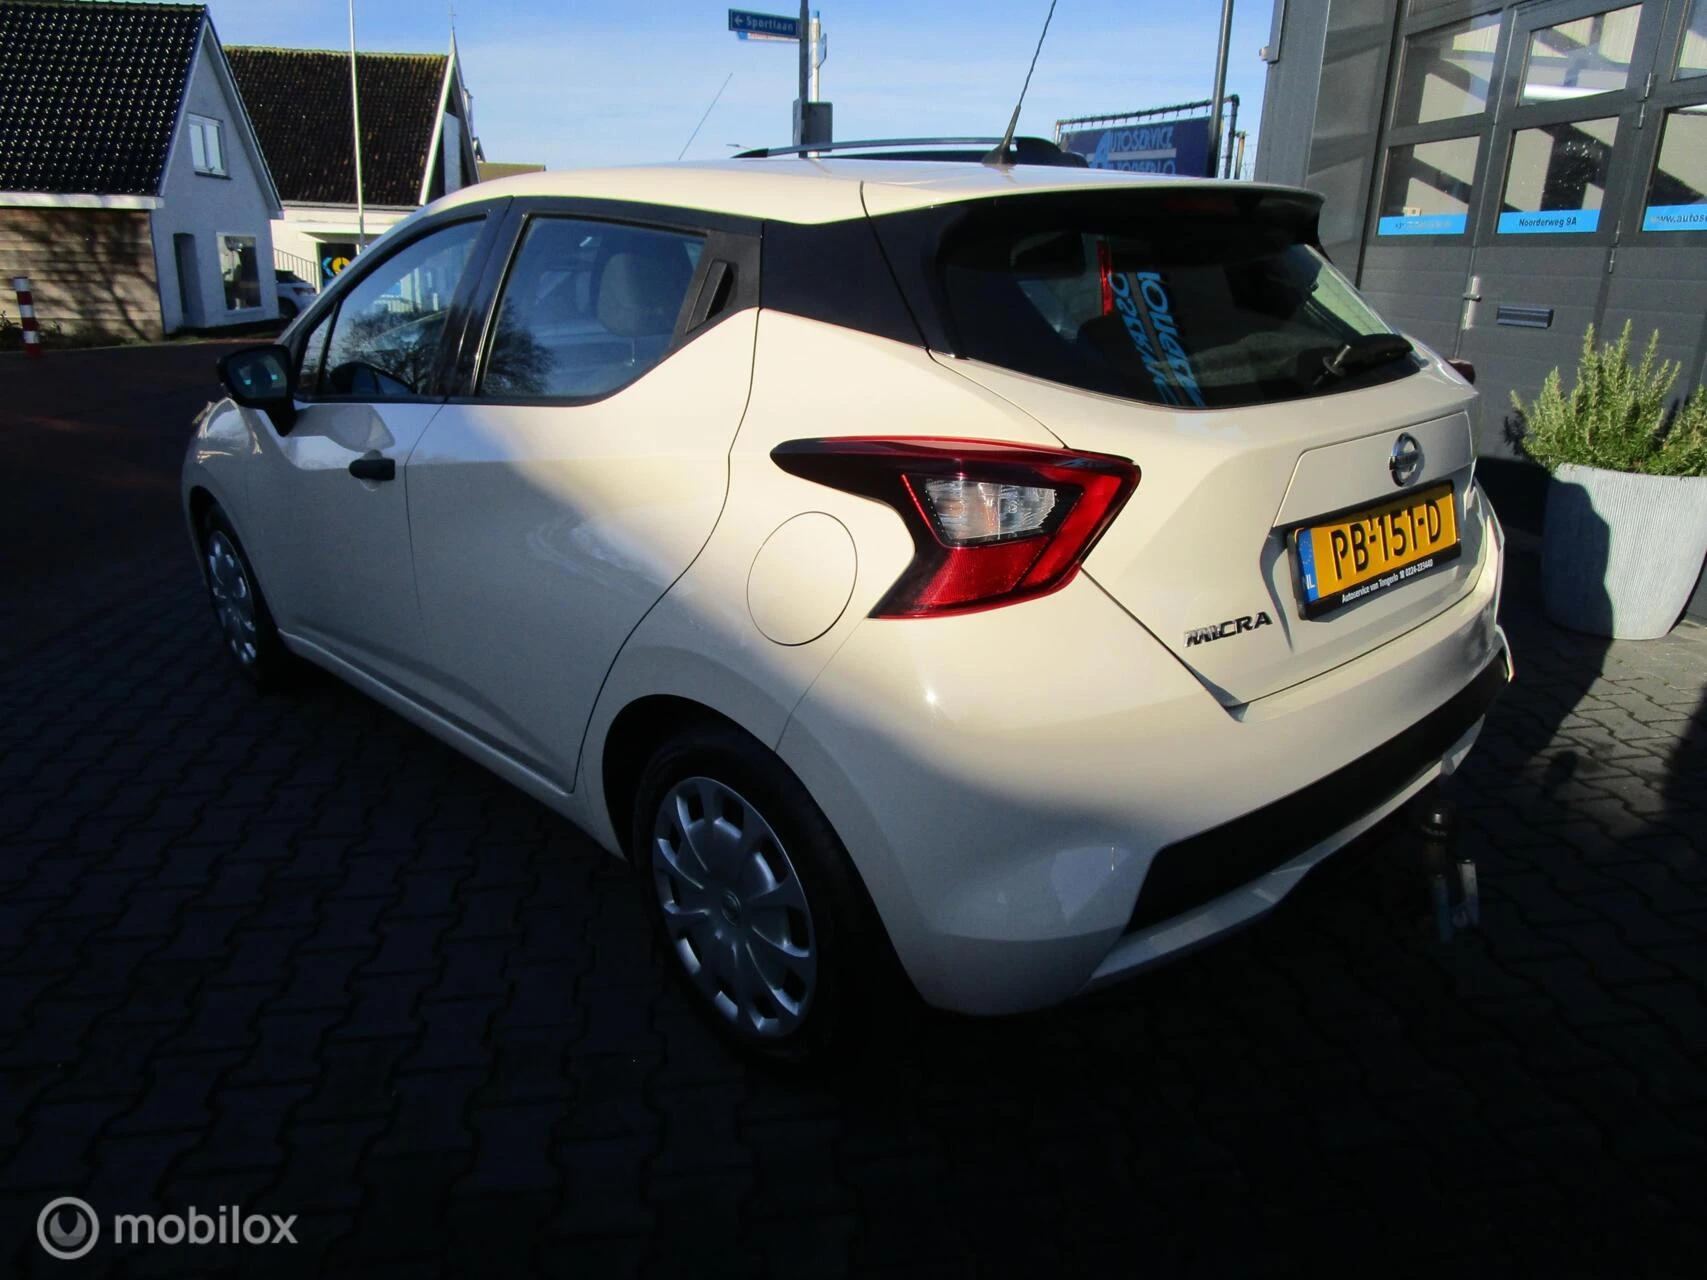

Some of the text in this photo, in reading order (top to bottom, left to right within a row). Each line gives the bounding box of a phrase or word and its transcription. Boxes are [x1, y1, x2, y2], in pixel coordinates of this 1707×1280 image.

[746, 15, 793, 33] Sportlaan
[1519, 217, 1577, 228] Noorderweg 9A
[1330, 499, 1443, 581] PB-151-D
[1342, 585, 1370, 604] Autoservice
[1370, 582, 1379, 591] van
[1378, 573, 1399, 587] Tongerlo
[1184, 610, 1273, 648] MICRA
